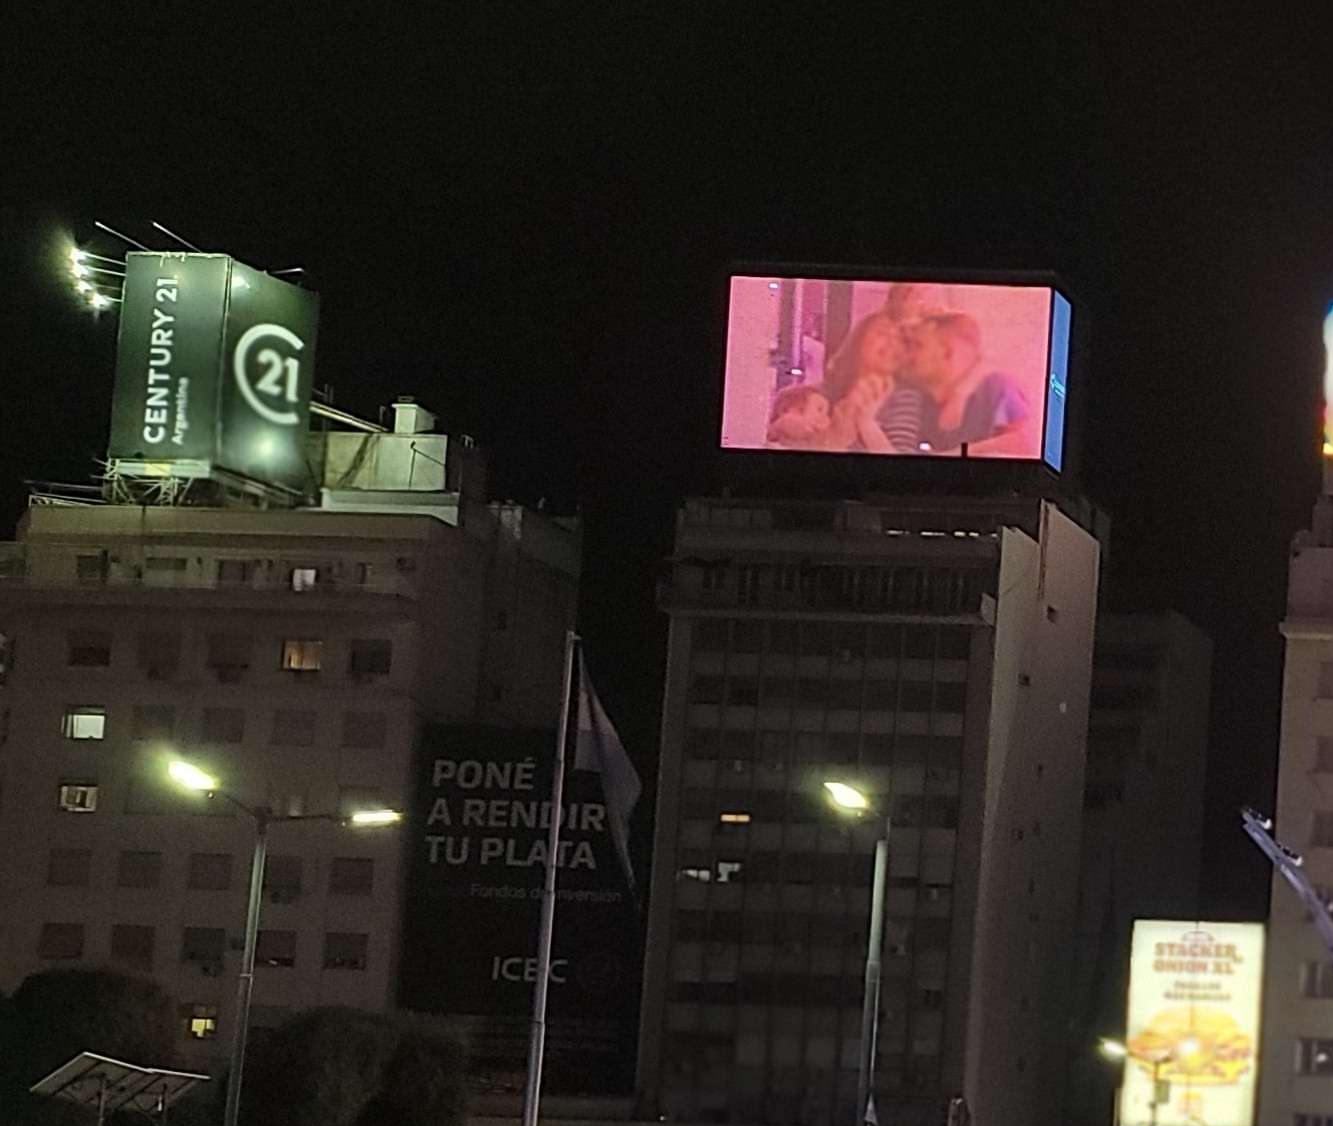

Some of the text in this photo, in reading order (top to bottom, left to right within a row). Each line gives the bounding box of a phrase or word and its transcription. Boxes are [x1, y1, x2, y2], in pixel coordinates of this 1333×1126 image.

[143, 278, 179, 444] CENTURY 21
[257, 349, 300, 403] 21
[171, 377, 189, 445] Argentina
[431, 756, 535, 791] PONÉ
[427, 798, 606, 832] A RENDIR
[426, 835, 598, 870] TU PLATA
[470, 883, 526, 899] Fondos
[557, 888, 624, 903] nversión
